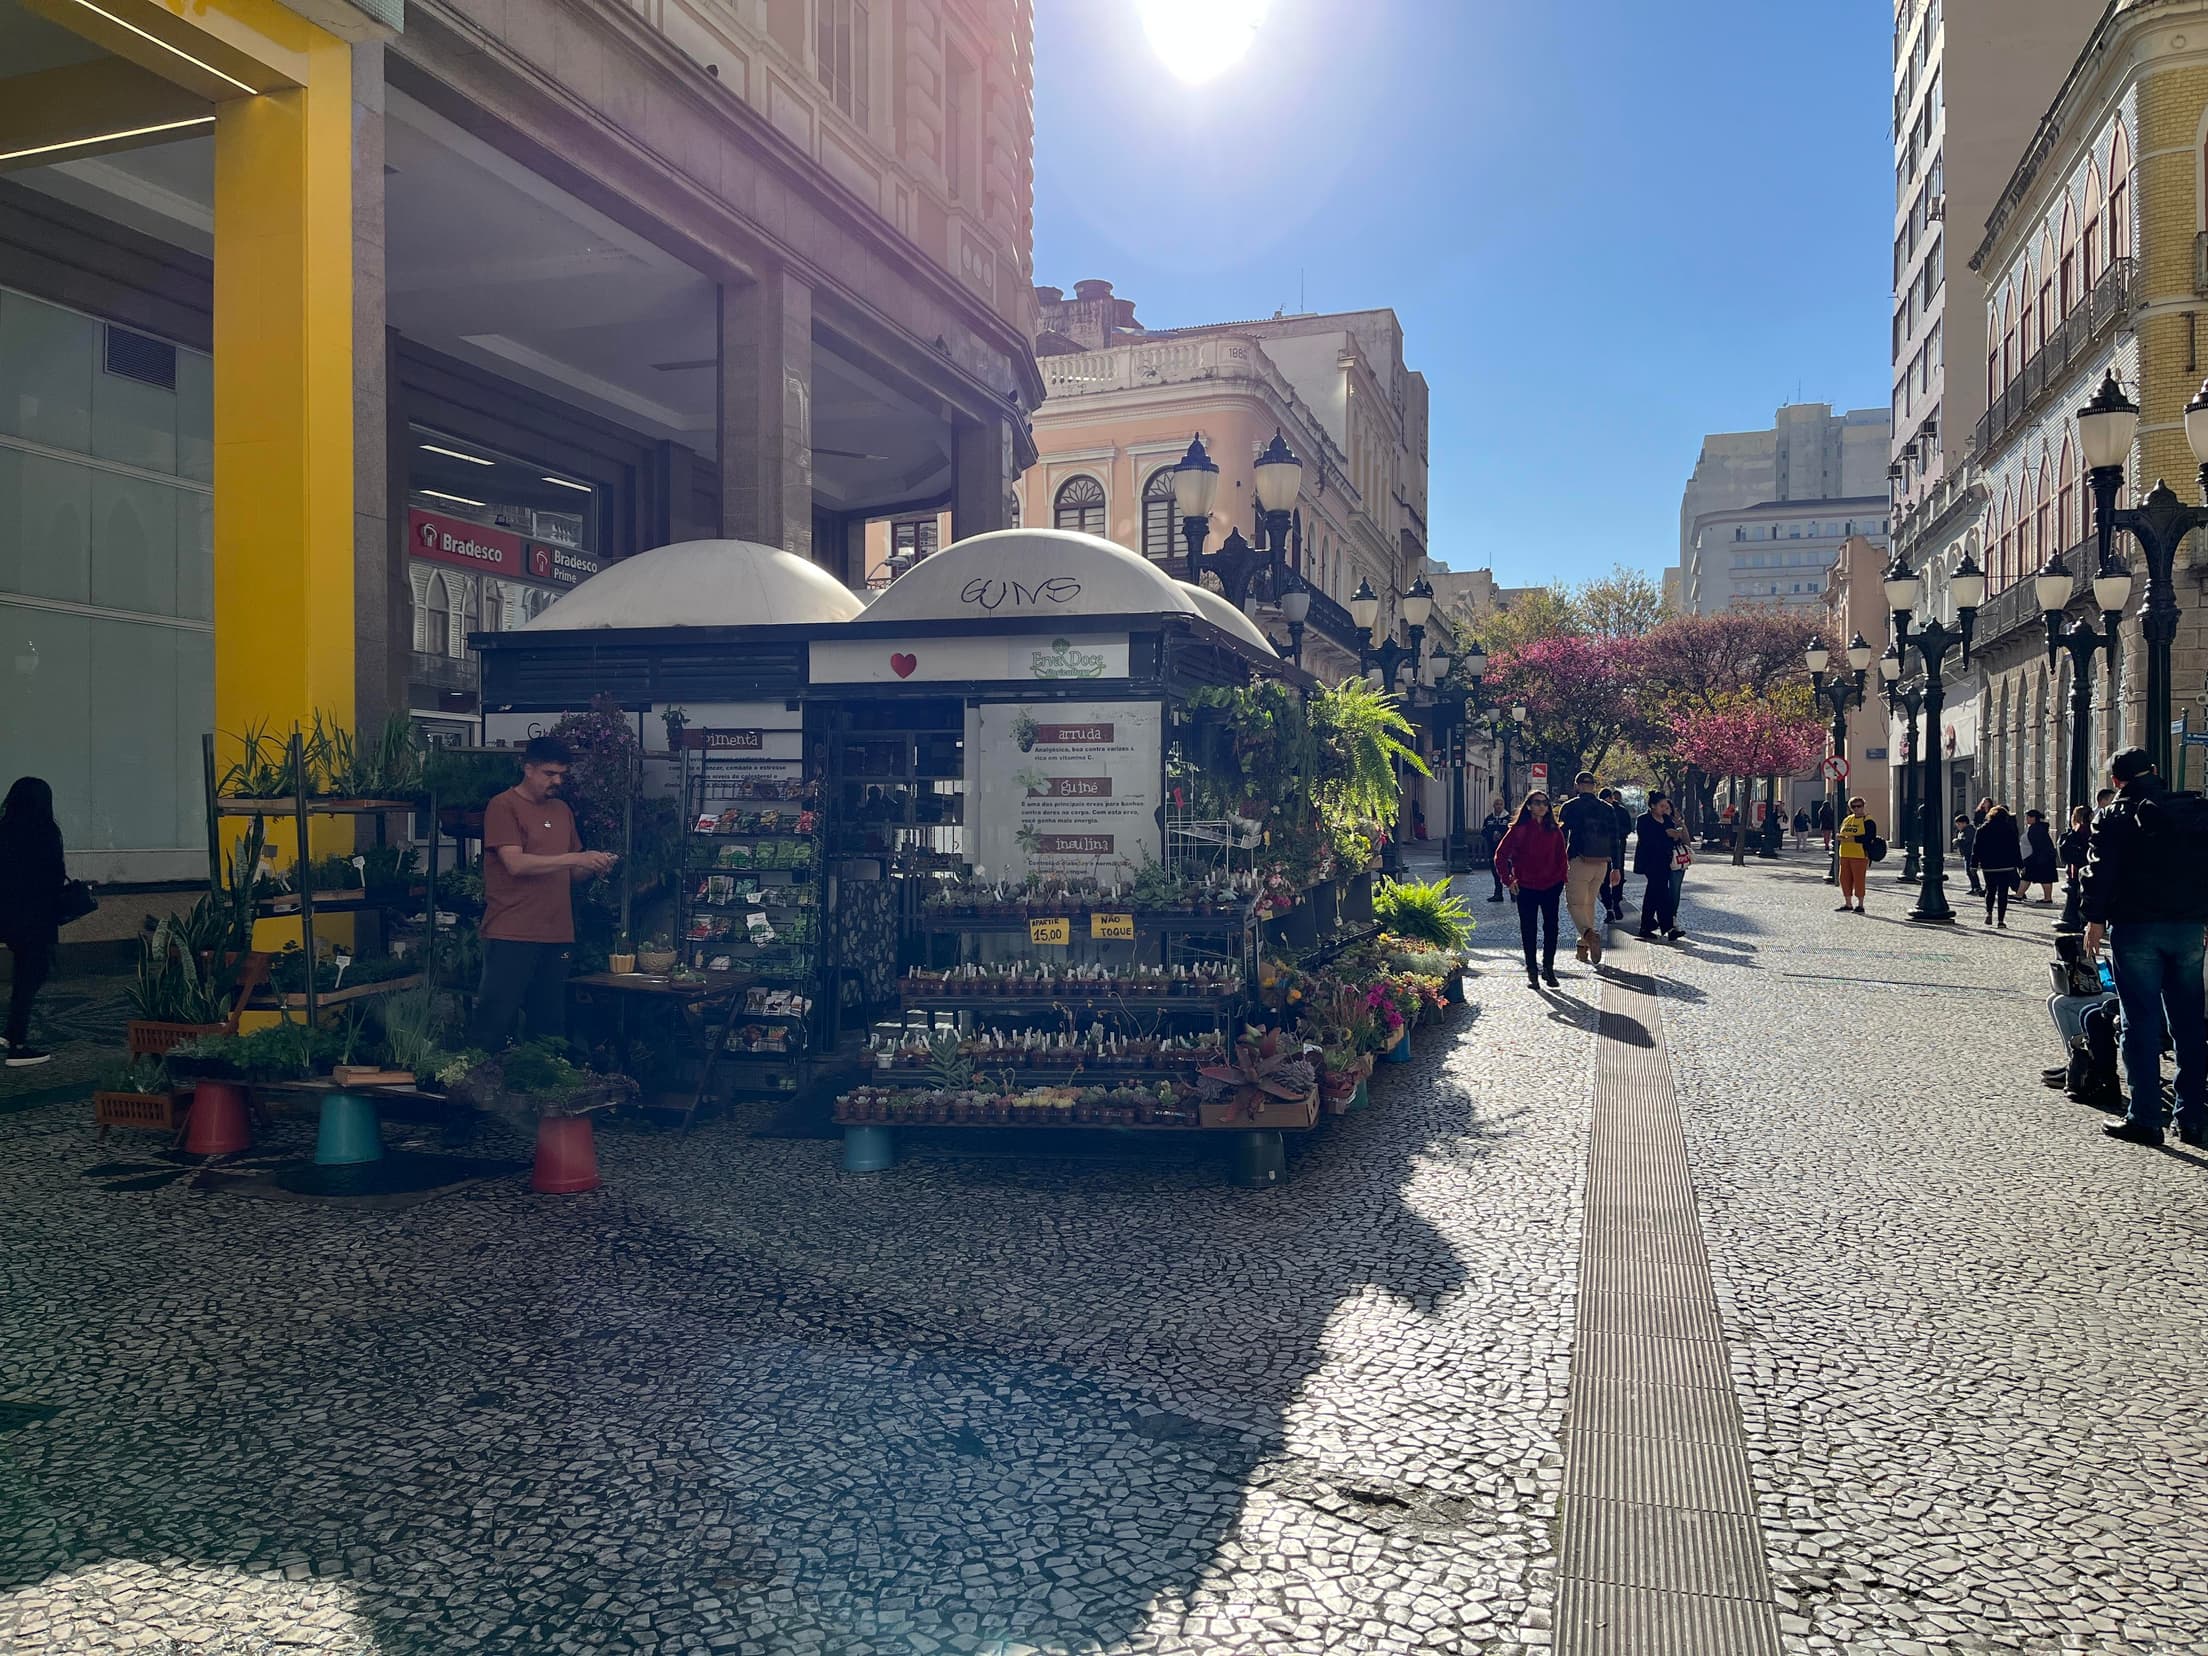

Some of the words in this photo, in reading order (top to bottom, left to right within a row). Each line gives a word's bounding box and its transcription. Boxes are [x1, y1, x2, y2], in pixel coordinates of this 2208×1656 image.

[442, 533, 503, 562] Bradesco
[554, 550, 598, 574] Bradesco
[554, 567, 577, 584] Prime
[961, 577, 1081, 609] GUNS
[1032, 652, 1064, 667] Erva
[1069, 650, 1104, 667] Doce
[1059, 728, 1102, 740] arruda
[1061, 780, 1098, 796] guiné
[1056, 837, 1108, 851] insulina
[1034, 929, 1062, 942] 15,00
[1100, 928, 1132, 937] TOQUE
